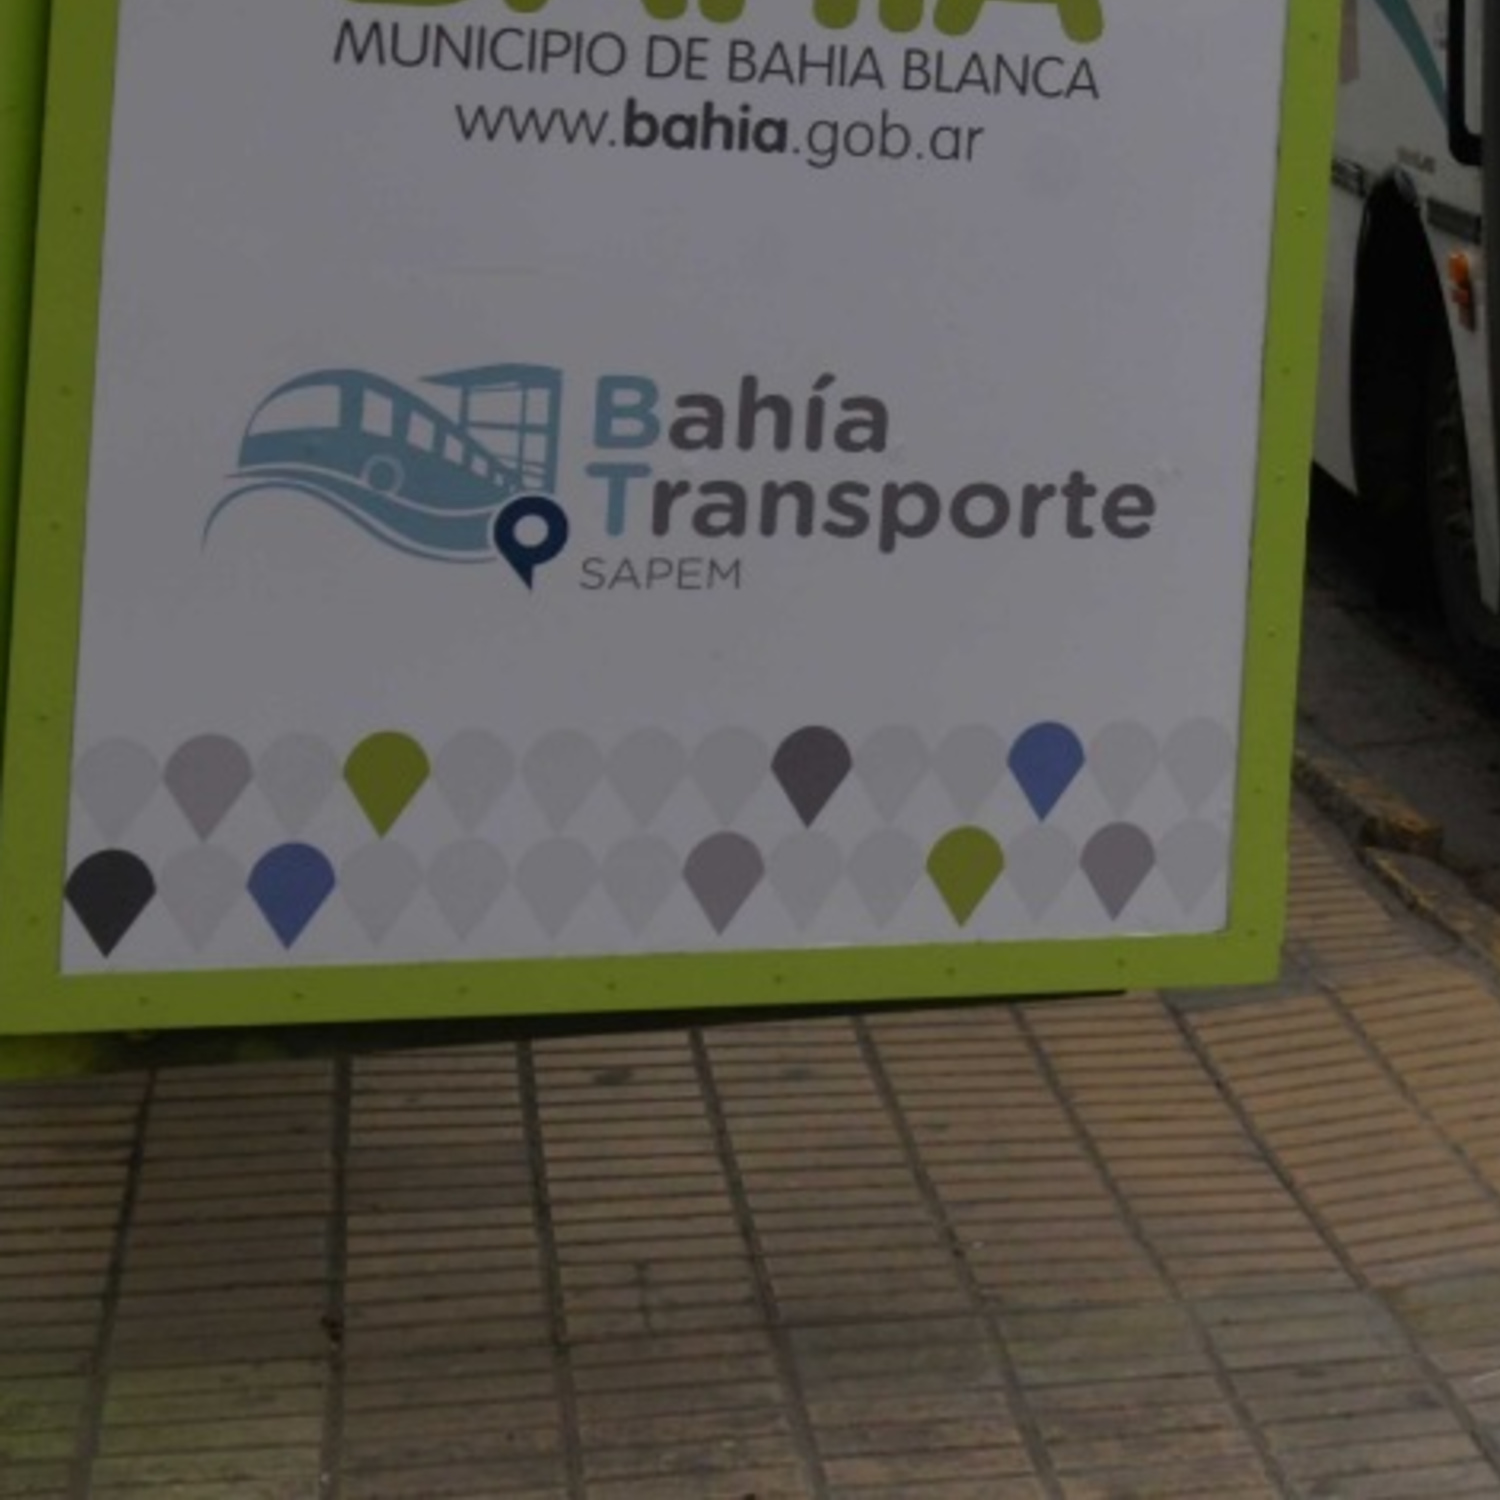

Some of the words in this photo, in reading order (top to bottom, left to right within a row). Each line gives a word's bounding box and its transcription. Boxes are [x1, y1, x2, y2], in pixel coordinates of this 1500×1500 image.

[333, 18, 627, 77] MUNICIPIO
[645, 34, 709, 81] DE
[727, 40, 886, 91] BAHIA
[902, 48, 1101, 100] BLANCA
[455, 97, 984, 169] www.bahia.gob.ar
[592, 372, 890, 453] Bahía
[586, 460, 1158, 554] Transporte
[579, 556, 743, 591] SAPEM
